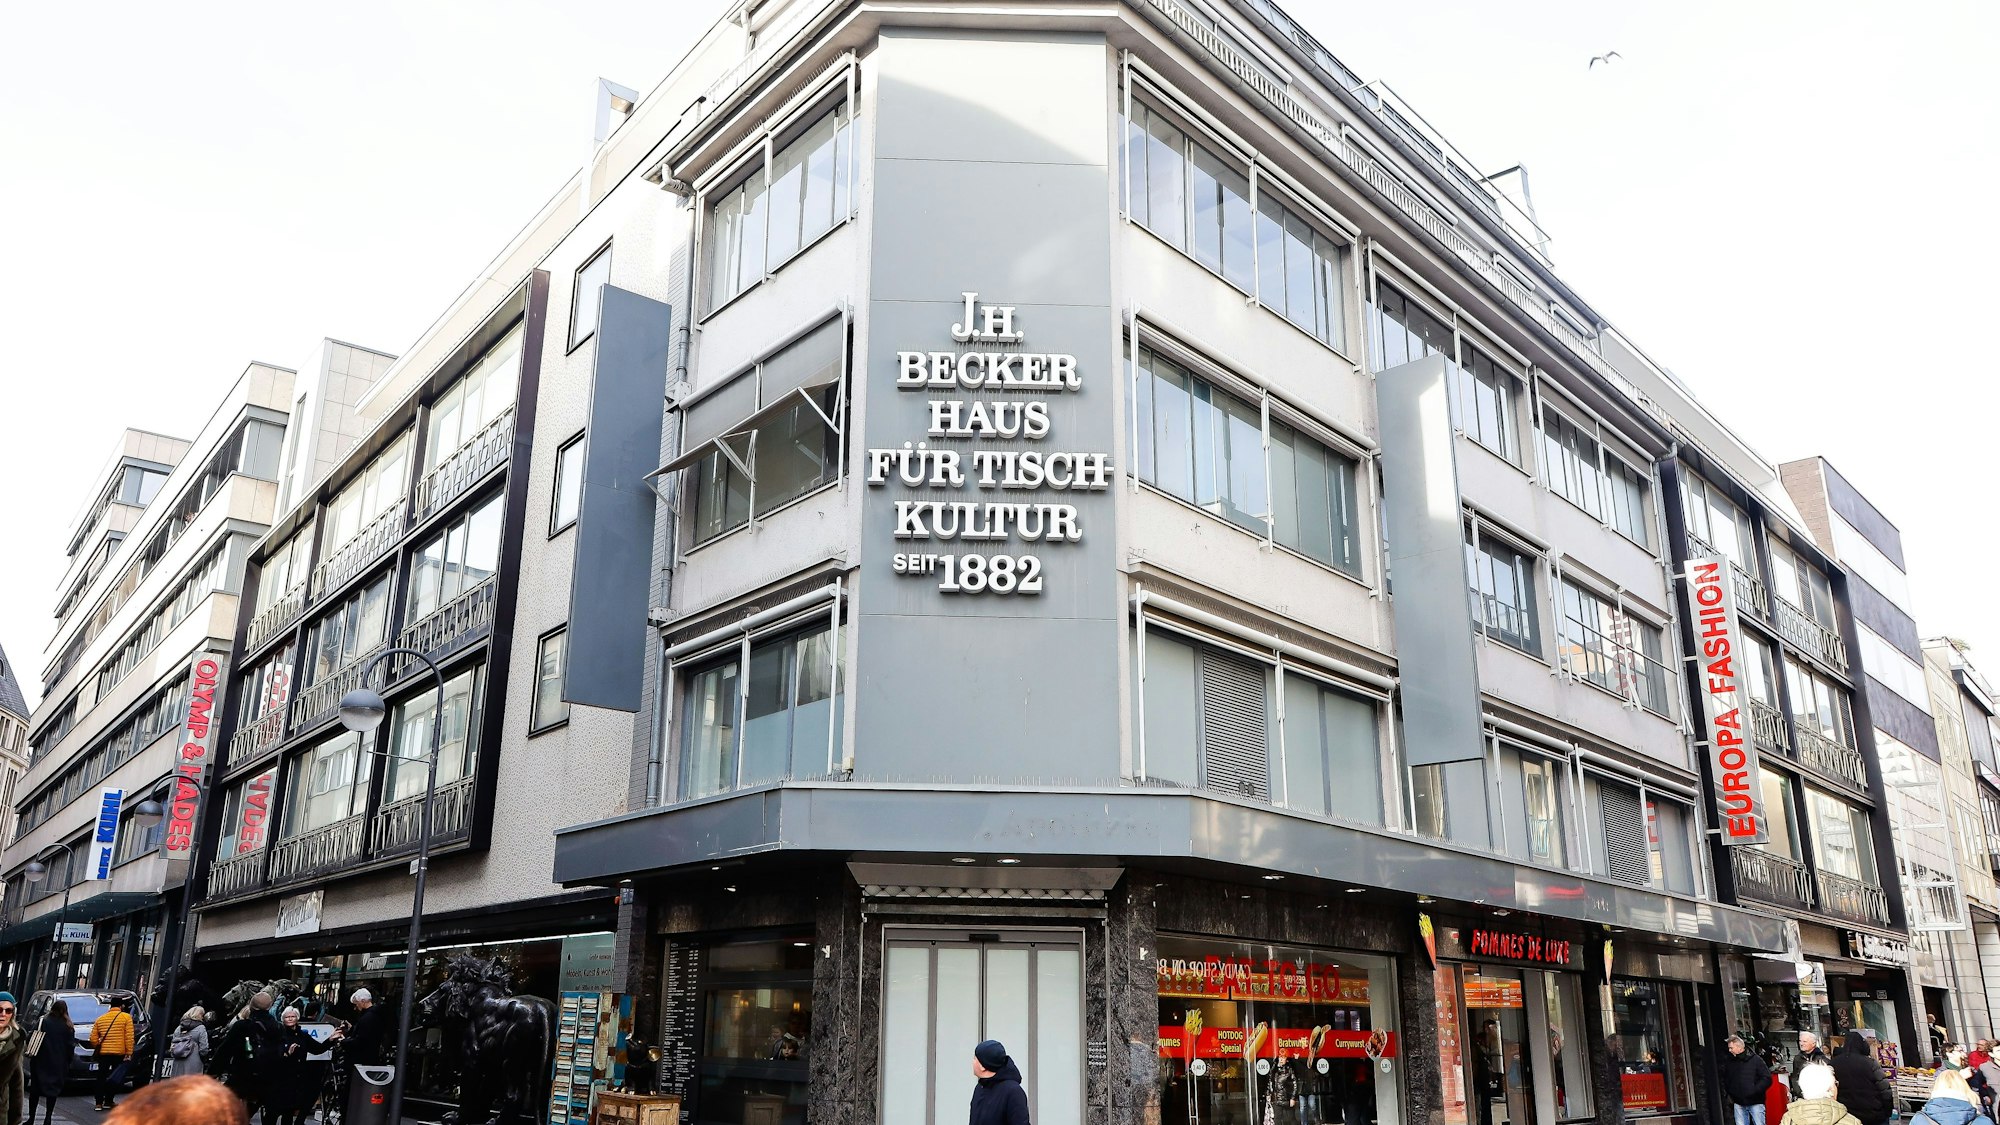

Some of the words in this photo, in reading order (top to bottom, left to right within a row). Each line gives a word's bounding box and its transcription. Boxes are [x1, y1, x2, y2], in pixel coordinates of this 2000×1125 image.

[951, 291, 1024, 343] J.H.
[896, 351, 1082, 392] BECKER
[927, 400, 1050, 439] HAUS
[867, 441, 965, 488] FÜR
[972, 450, 1115, 491] TISCH-
[893, 500, 1083, 543] KULTUR
[892, 552, 938, 575] SEIT
[938, 553, 1043, 595] 1882
[1693, 562, 1736, 694] FASHION
[186, 659, 219, 740] OLYMP
[182, 742, 205, 761] &
[1713, 707, 1757, 838] EUROPA
[165, 765, 202, 852] HADES
[1471, 929, 1525, 959] POMMES
[1527, 935, 1542, 961] DE
[1545, 939, 1570, 964] LUXE
[1206, 954, 1256, 996] EAT
[1264, 959, 1296, 997] TO
[1306, 963, 1340, 1000] GO
[1218, 1030, 1243, 1041] HOTDOG
[1220, 1043, 1242, 1054] Spezial
[1278, 1038, 1308, 1049] Bratwurst
[1335, 1038, 1366, 1050] Currywurst
